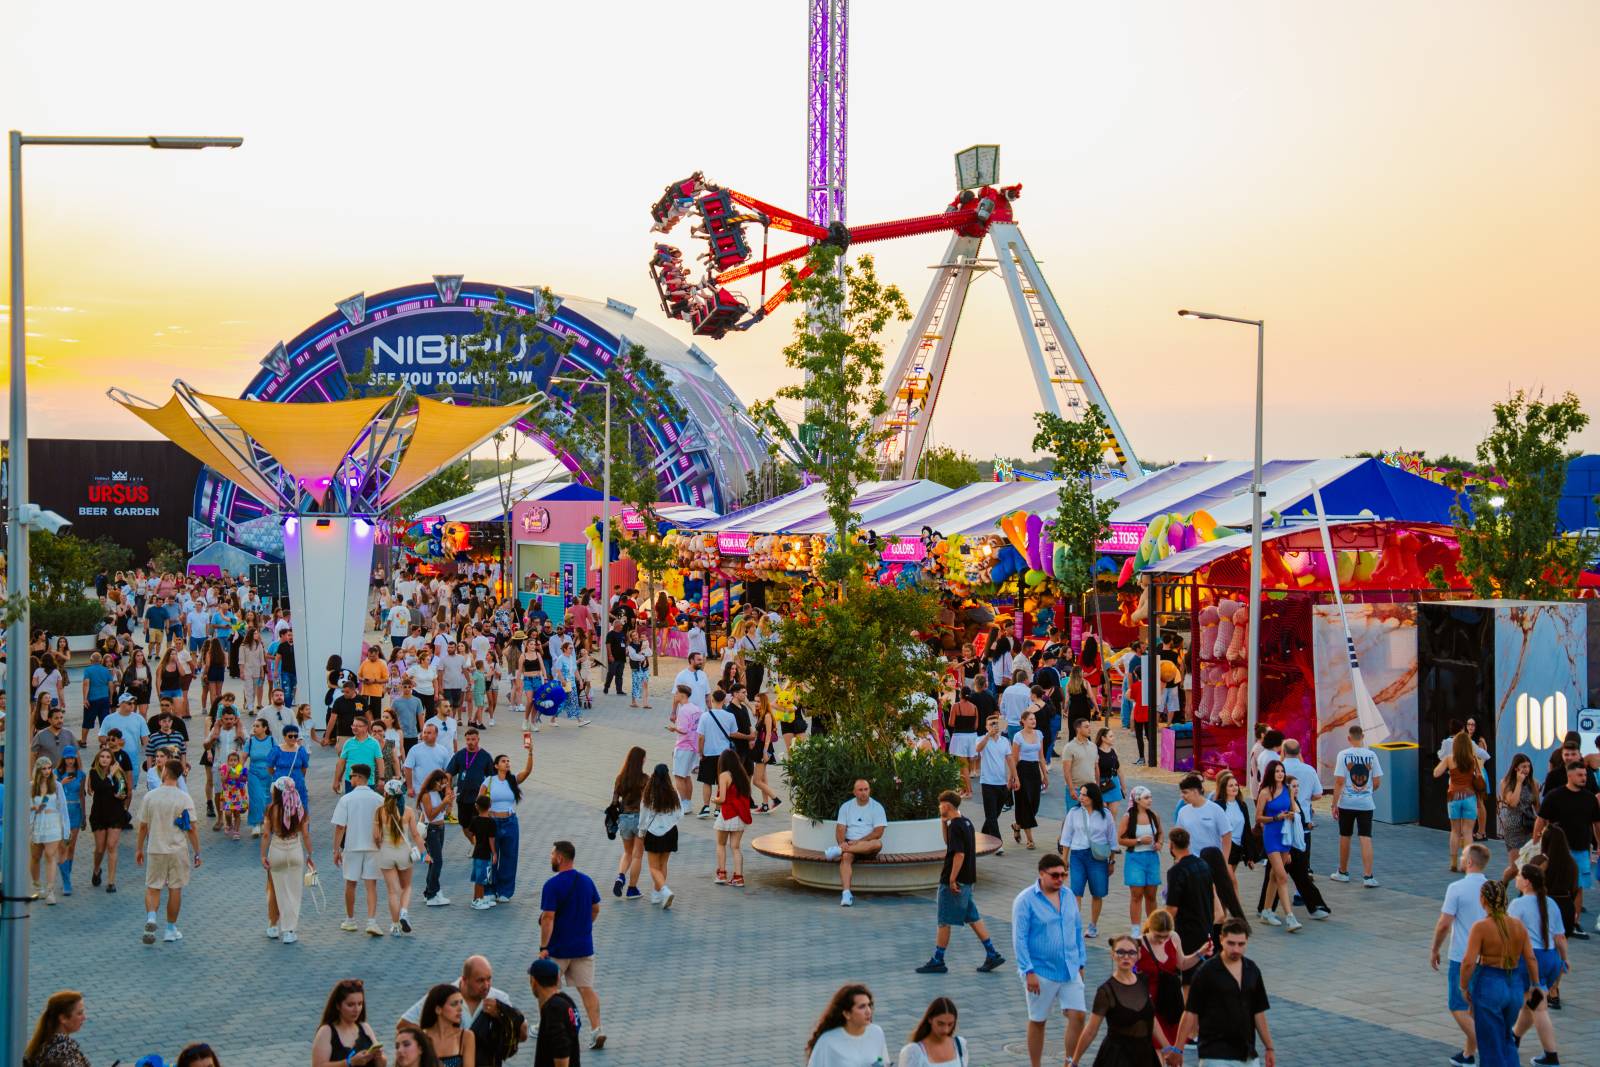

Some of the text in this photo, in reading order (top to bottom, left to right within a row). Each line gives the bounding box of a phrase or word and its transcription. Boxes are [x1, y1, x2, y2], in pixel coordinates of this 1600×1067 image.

[368, 372, 395, 386] SEE
[400, 372, 432, 386] YOU
[88, 483, 150, 504] URSUS
[79, 507, 160, 516] BEER GARDEN
[1119, 531, 1139, 545] TOSS
[891, 543, 915, 555] COLORS
